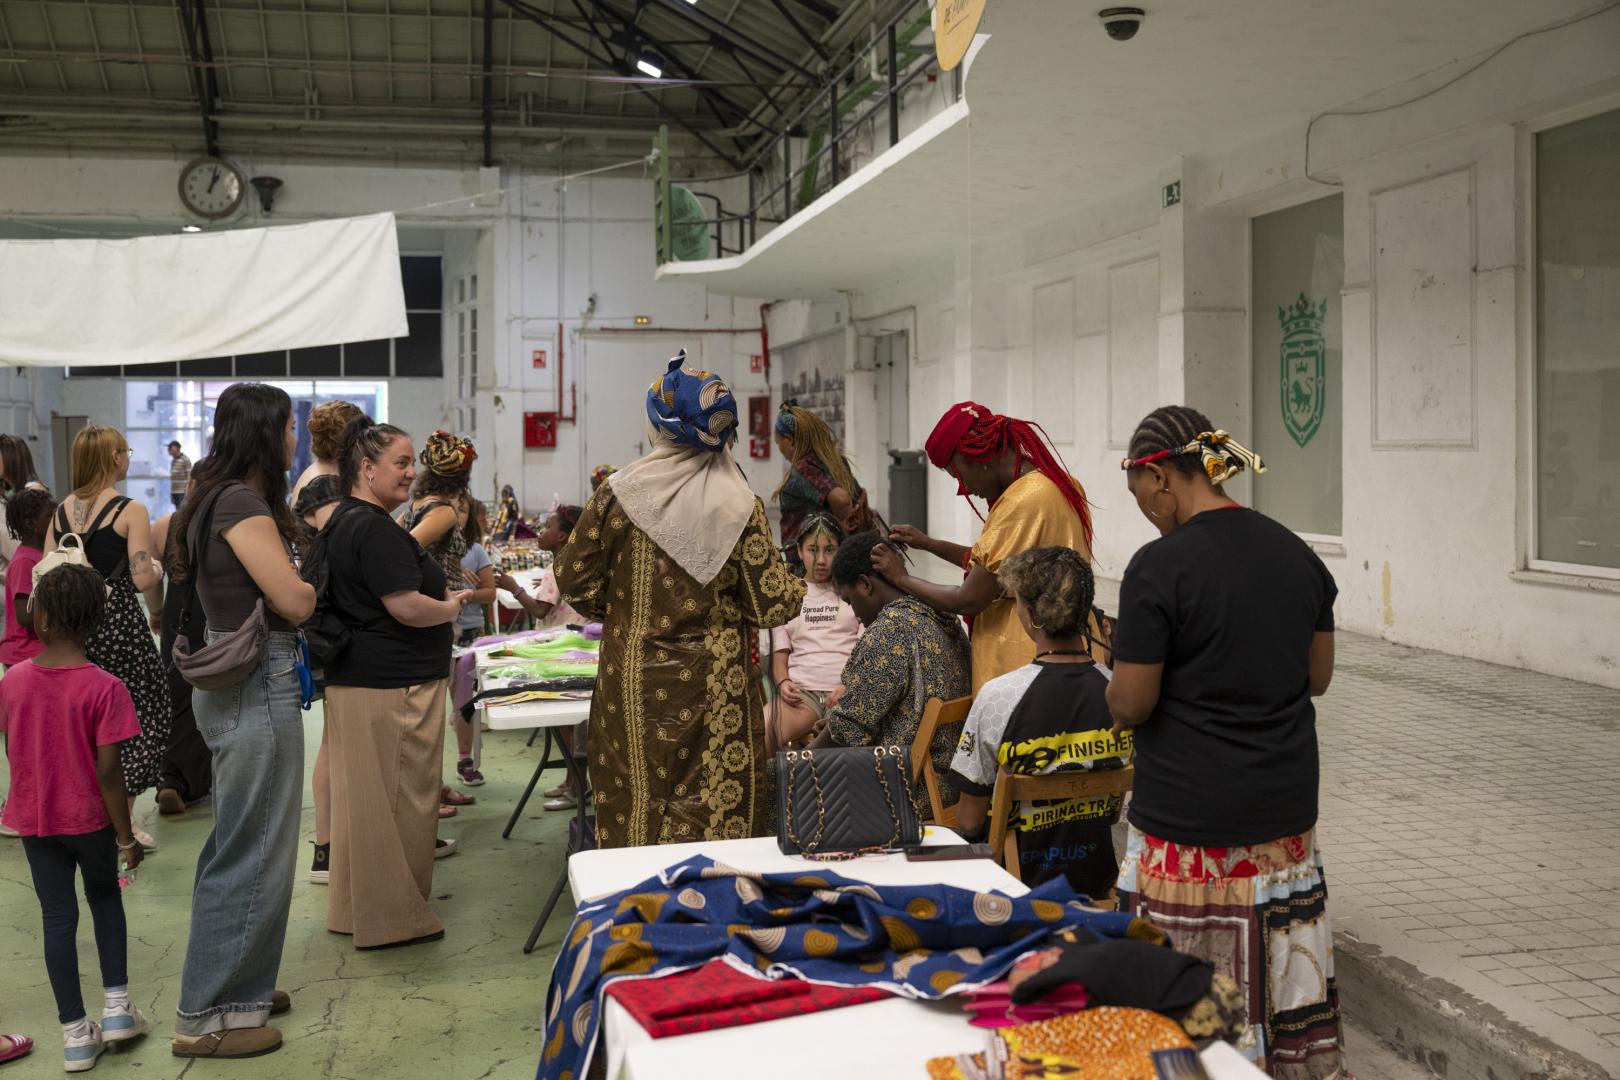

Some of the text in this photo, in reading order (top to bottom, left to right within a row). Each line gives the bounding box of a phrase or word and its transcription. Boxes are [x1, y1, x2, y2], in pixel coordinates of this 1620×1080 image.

[802, 606, 824, 614] Spread
[805, 614, 836, 624] Happiness
[1033, 802, 1086, 825] PIRINAC
